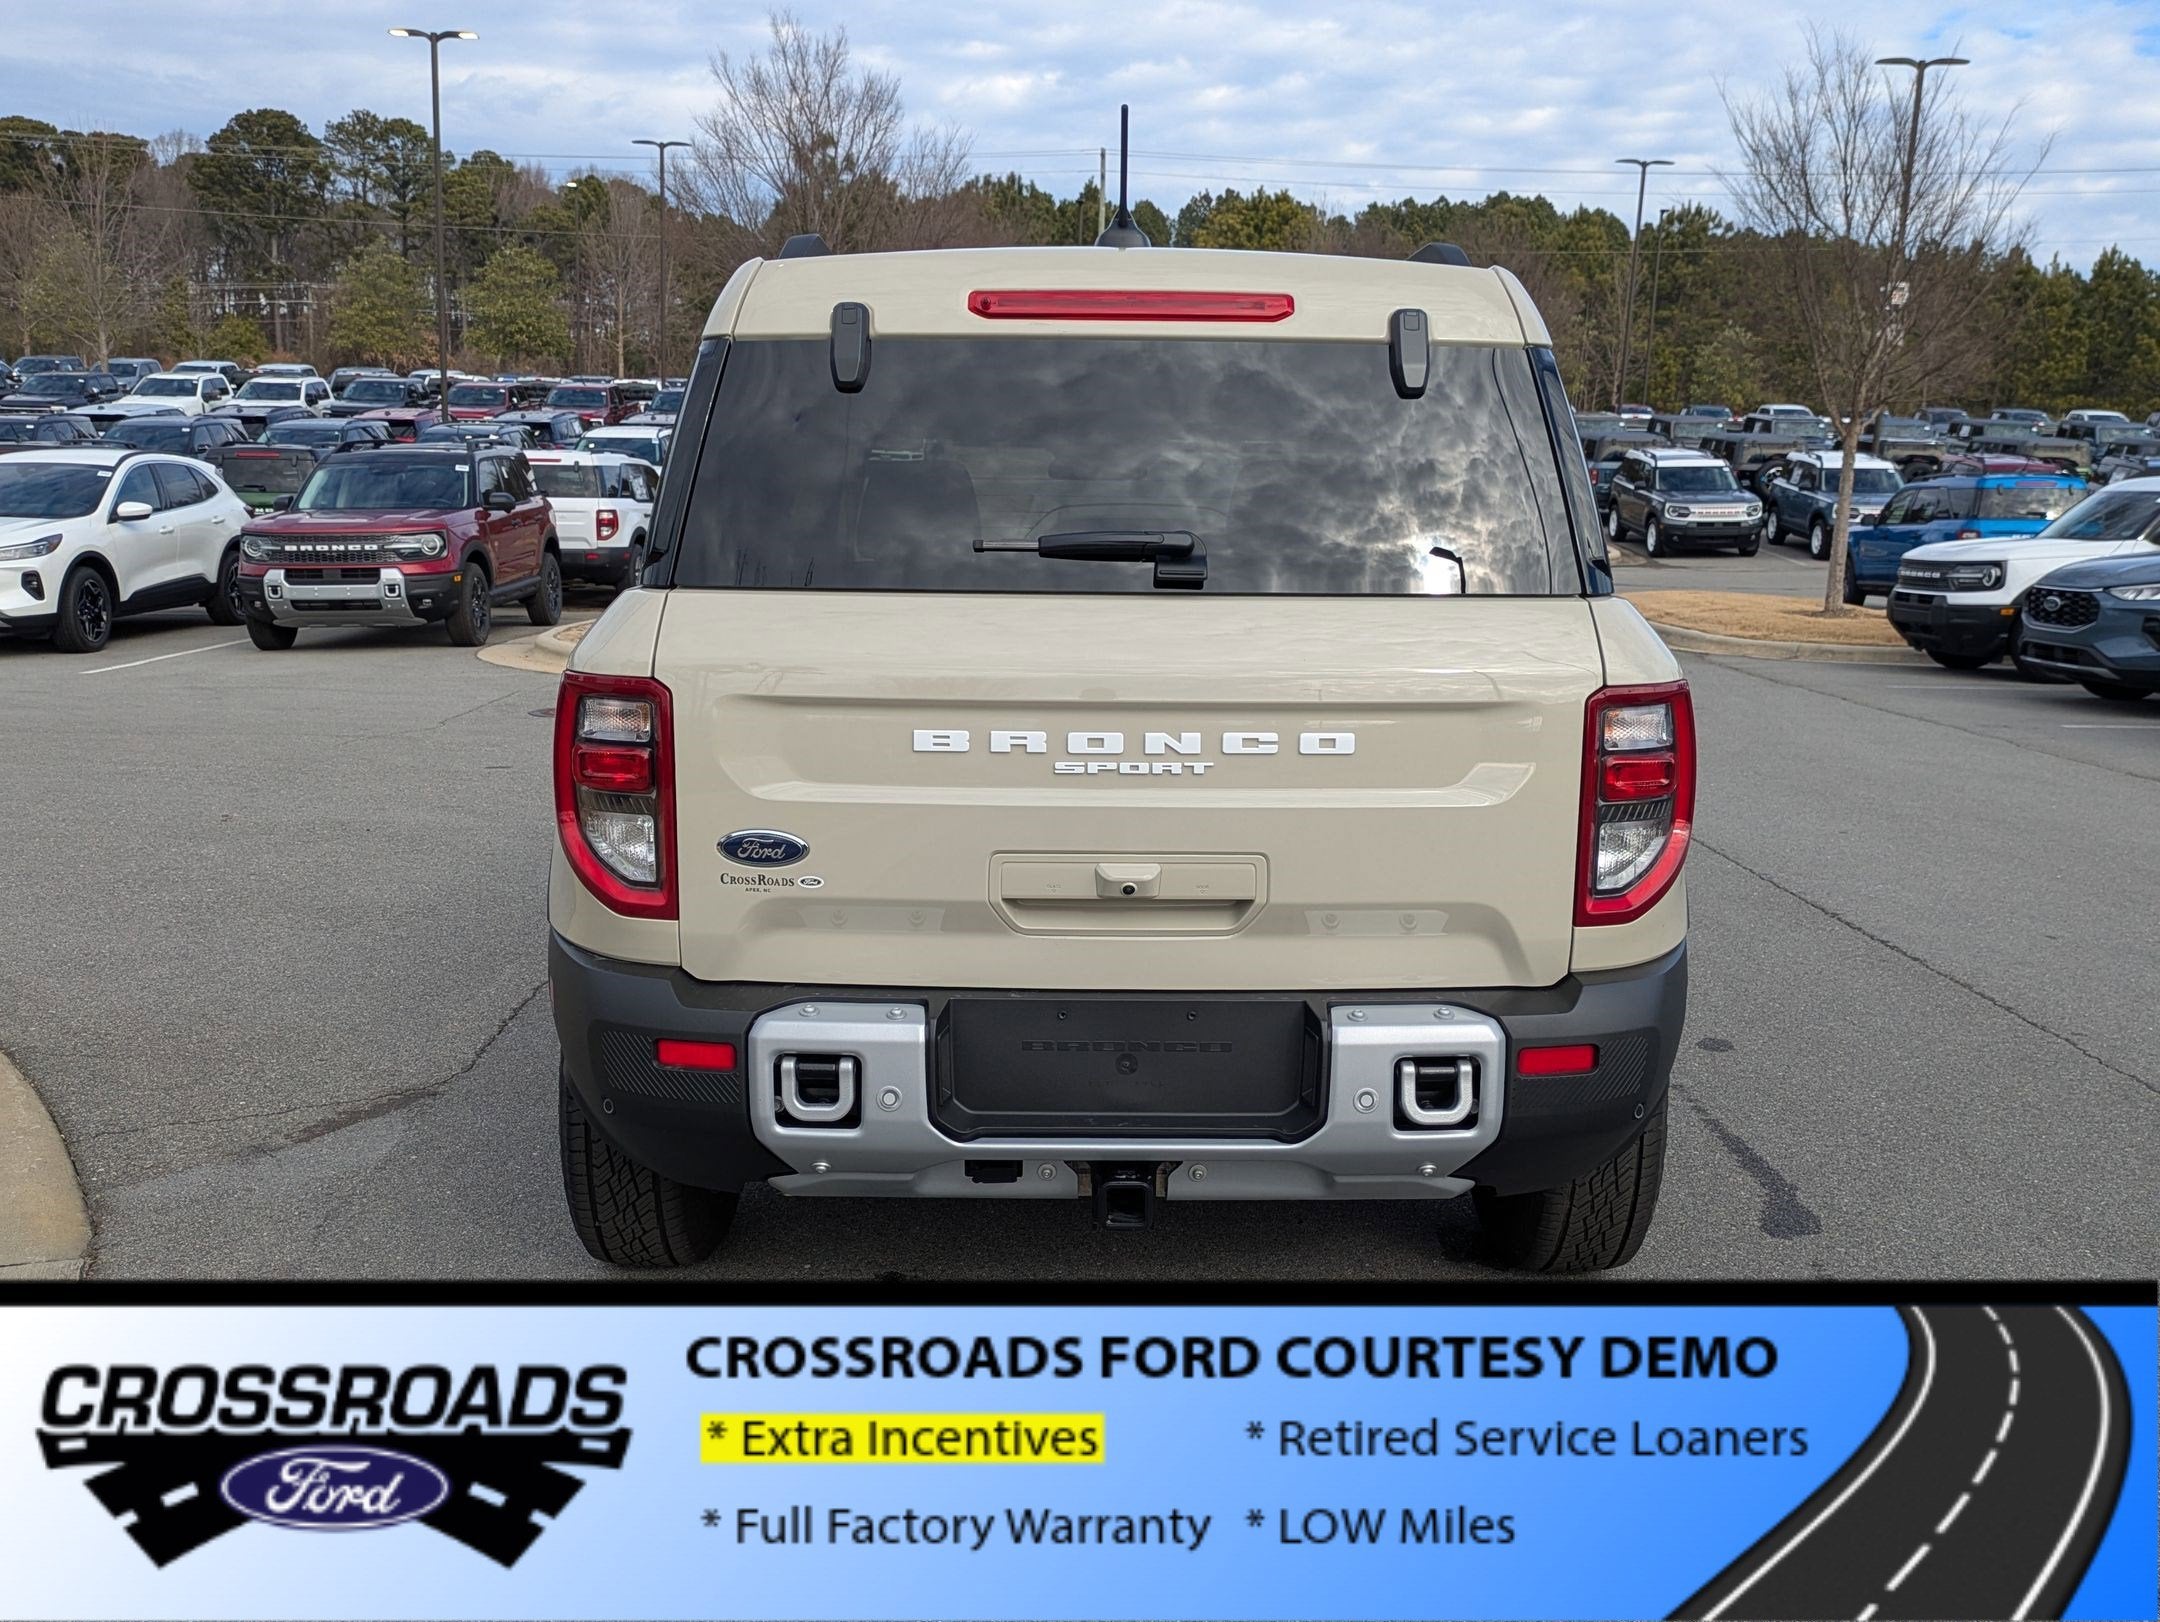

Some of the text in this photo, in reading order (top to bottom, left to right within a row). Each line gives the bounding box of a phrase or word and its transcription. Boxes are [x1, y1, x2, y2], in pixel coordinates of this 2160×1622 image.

[284, 544, 379, 552] BRONCO
[913, 730, 1356, 755] BRONCO
[1053, 761, 1215, 775] SPORT
[737, 837, 787, 860] Ford
[720, 872, 795, 887] CROSSROADS
[1021, 1040, 1233, 1052] BRONCO
